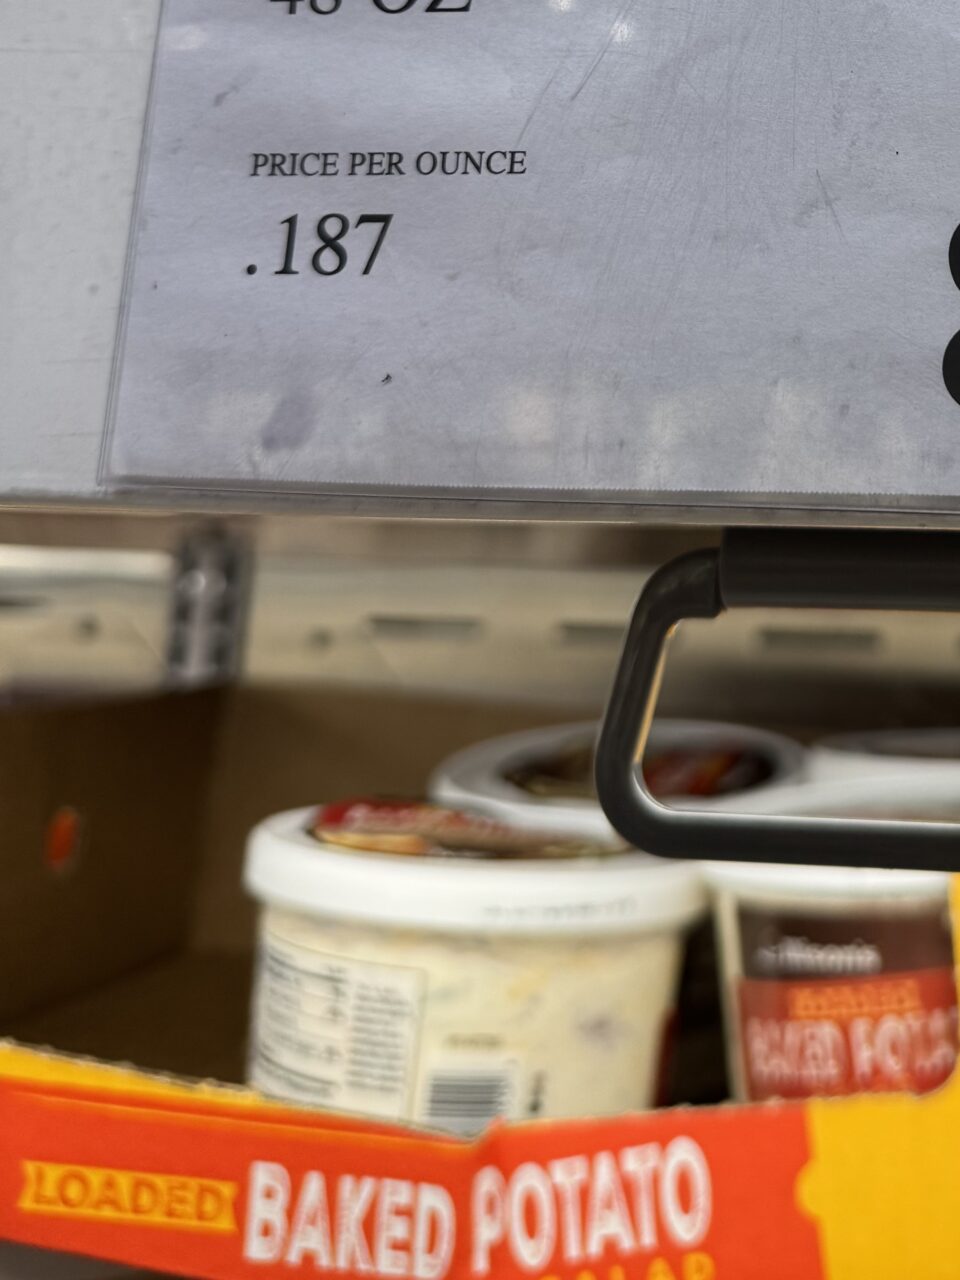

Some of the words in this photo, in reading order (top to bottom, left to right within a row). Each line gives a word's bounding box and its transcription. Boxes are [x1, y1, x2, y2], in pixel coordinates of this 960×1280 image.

[250, 152, 339, 177] PRICE
[348, 152, 406, 176] PER
[416, 150, 527, 175] OUNCE
[246, 213, 394, 275] .187
[33, 1166, 226, 1222] LOADED
[243, 1159, 457, 1279] BAKED
[470, 1135, 713, 1275] POTATO
